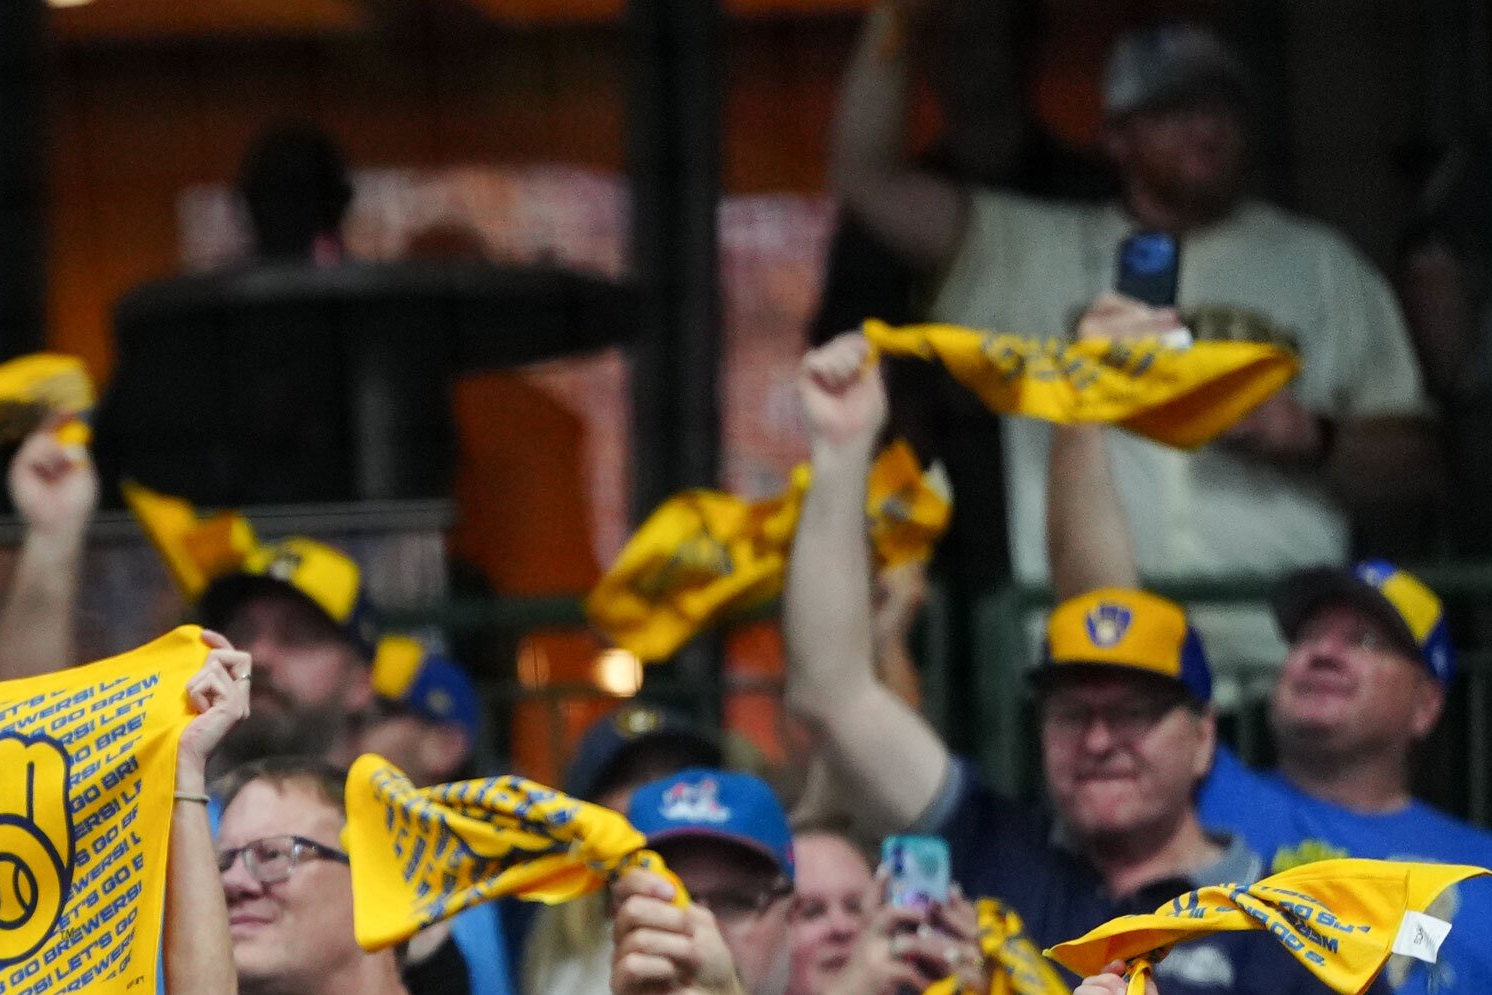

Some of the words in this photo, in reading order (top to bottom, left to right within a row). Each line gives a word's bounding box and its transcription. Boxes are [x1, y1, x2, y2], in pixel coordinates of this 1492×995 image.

[51, 707, 85, 731] GO
[92, 825, 118, 854] GO
[102, 865, 131, 895] GO
[55, 930, 112, 980] LET'S
[9, 959, 41, 987] GO
